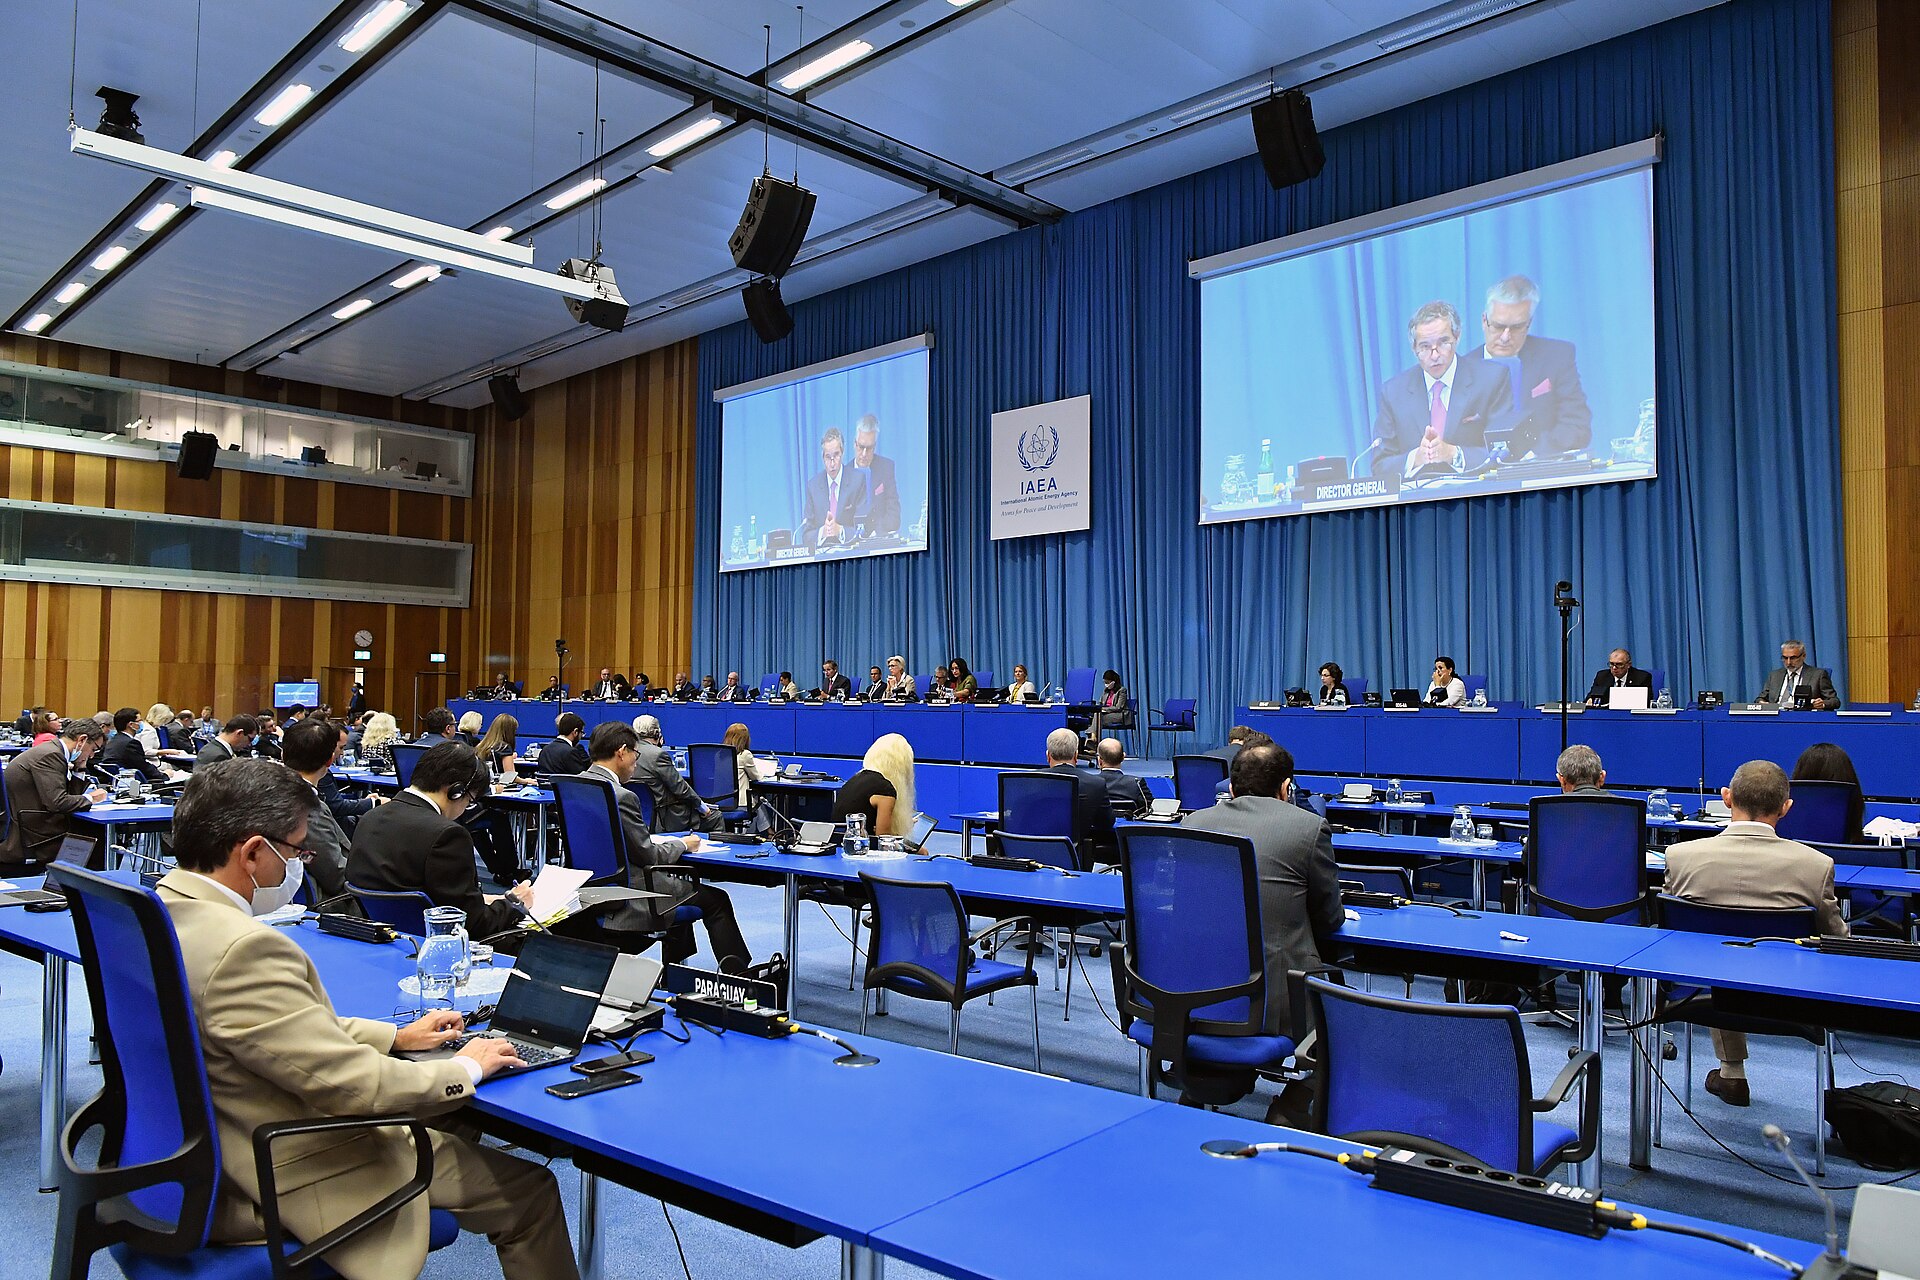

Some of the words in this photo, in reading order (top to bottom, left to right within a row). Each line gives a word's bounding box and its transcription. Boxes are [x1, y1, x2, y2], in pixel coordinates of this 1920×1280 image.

[1021, 477, 1057, 495] IAEA
[1316, 484, 1352, 499] DIRECTOR
[1352, 480, 1387, 496] GENERAL
[1001, 497, 1027, 505] International
[695, 977, 745, 1003] PARAGUAY
